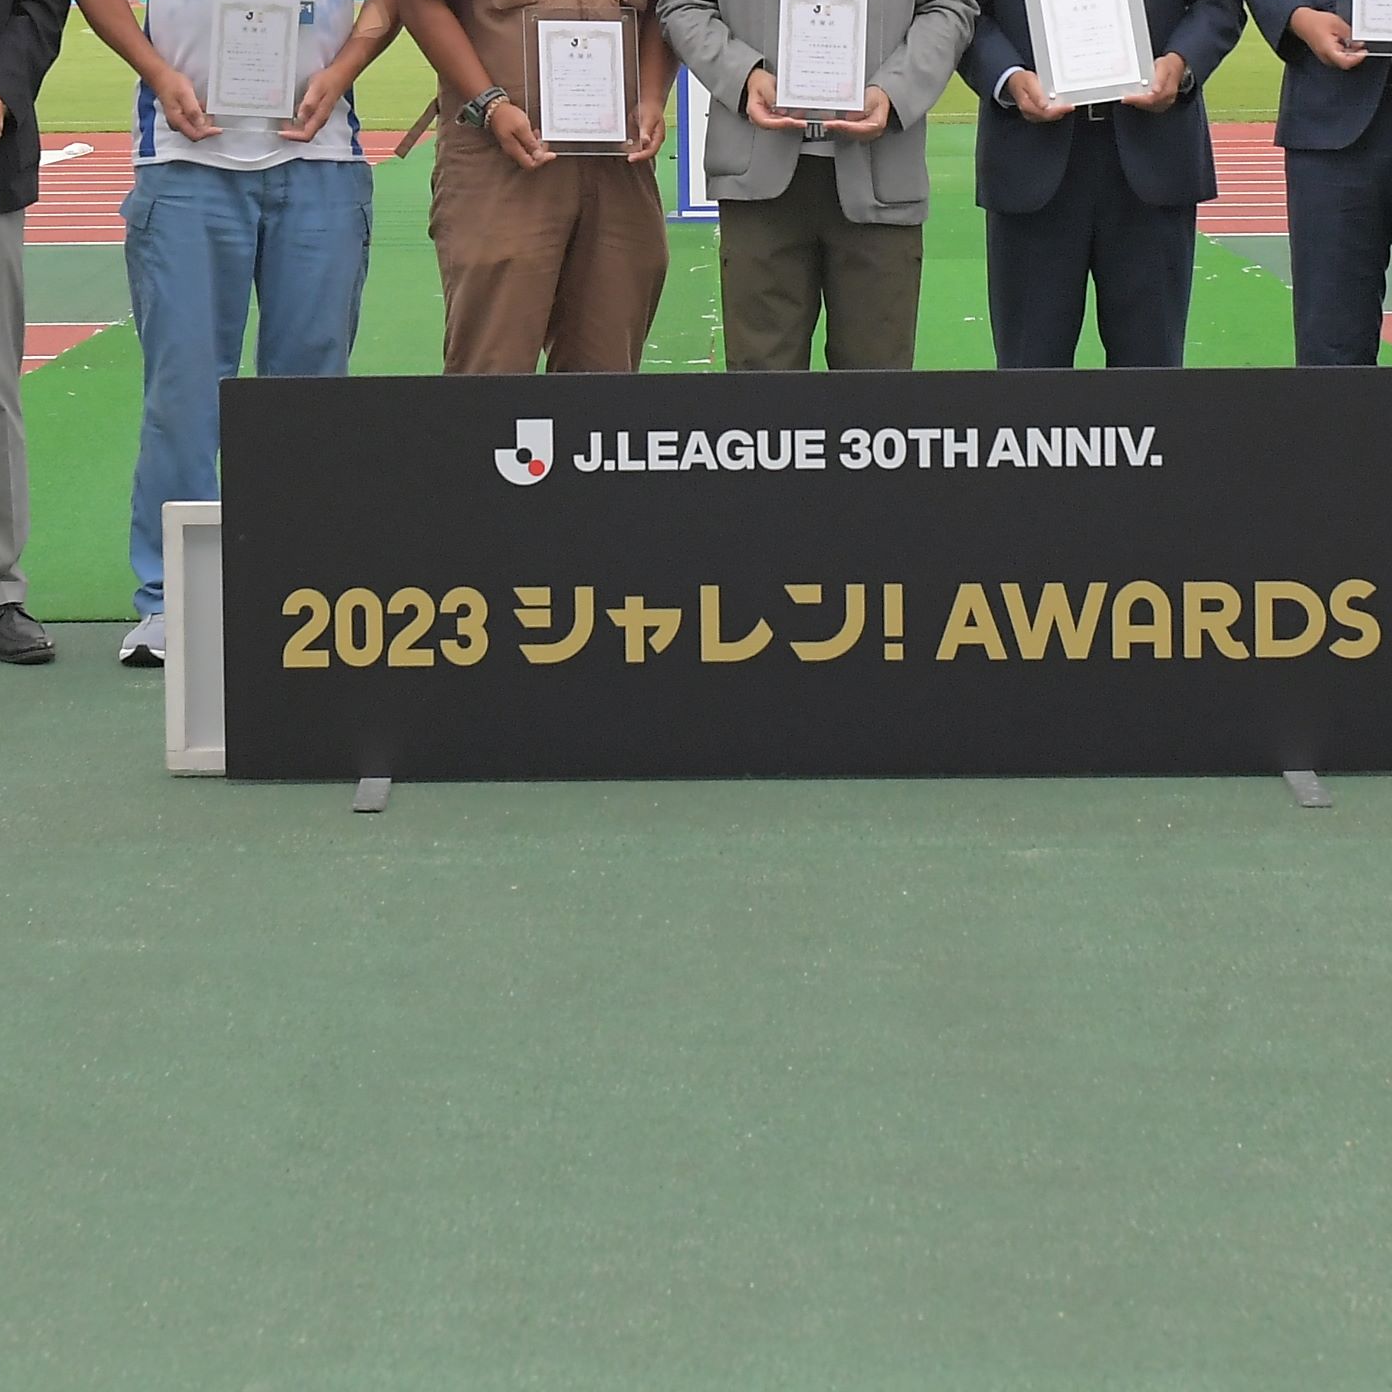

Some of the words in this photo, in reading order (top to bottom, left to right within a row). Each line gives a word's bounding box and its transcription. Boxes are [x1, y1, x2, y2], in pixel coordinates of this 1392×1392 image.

[573, 429, 826, 472] J.LEAGUE
[839, 427, 979, 470] 30TH
[986, 426, 1163, 468] ANNIV.
[281, 586, 489, 668] 2023
[512, 583, 904, 664] シャレン!
[935, 578, 1382, 661] AWARDS
